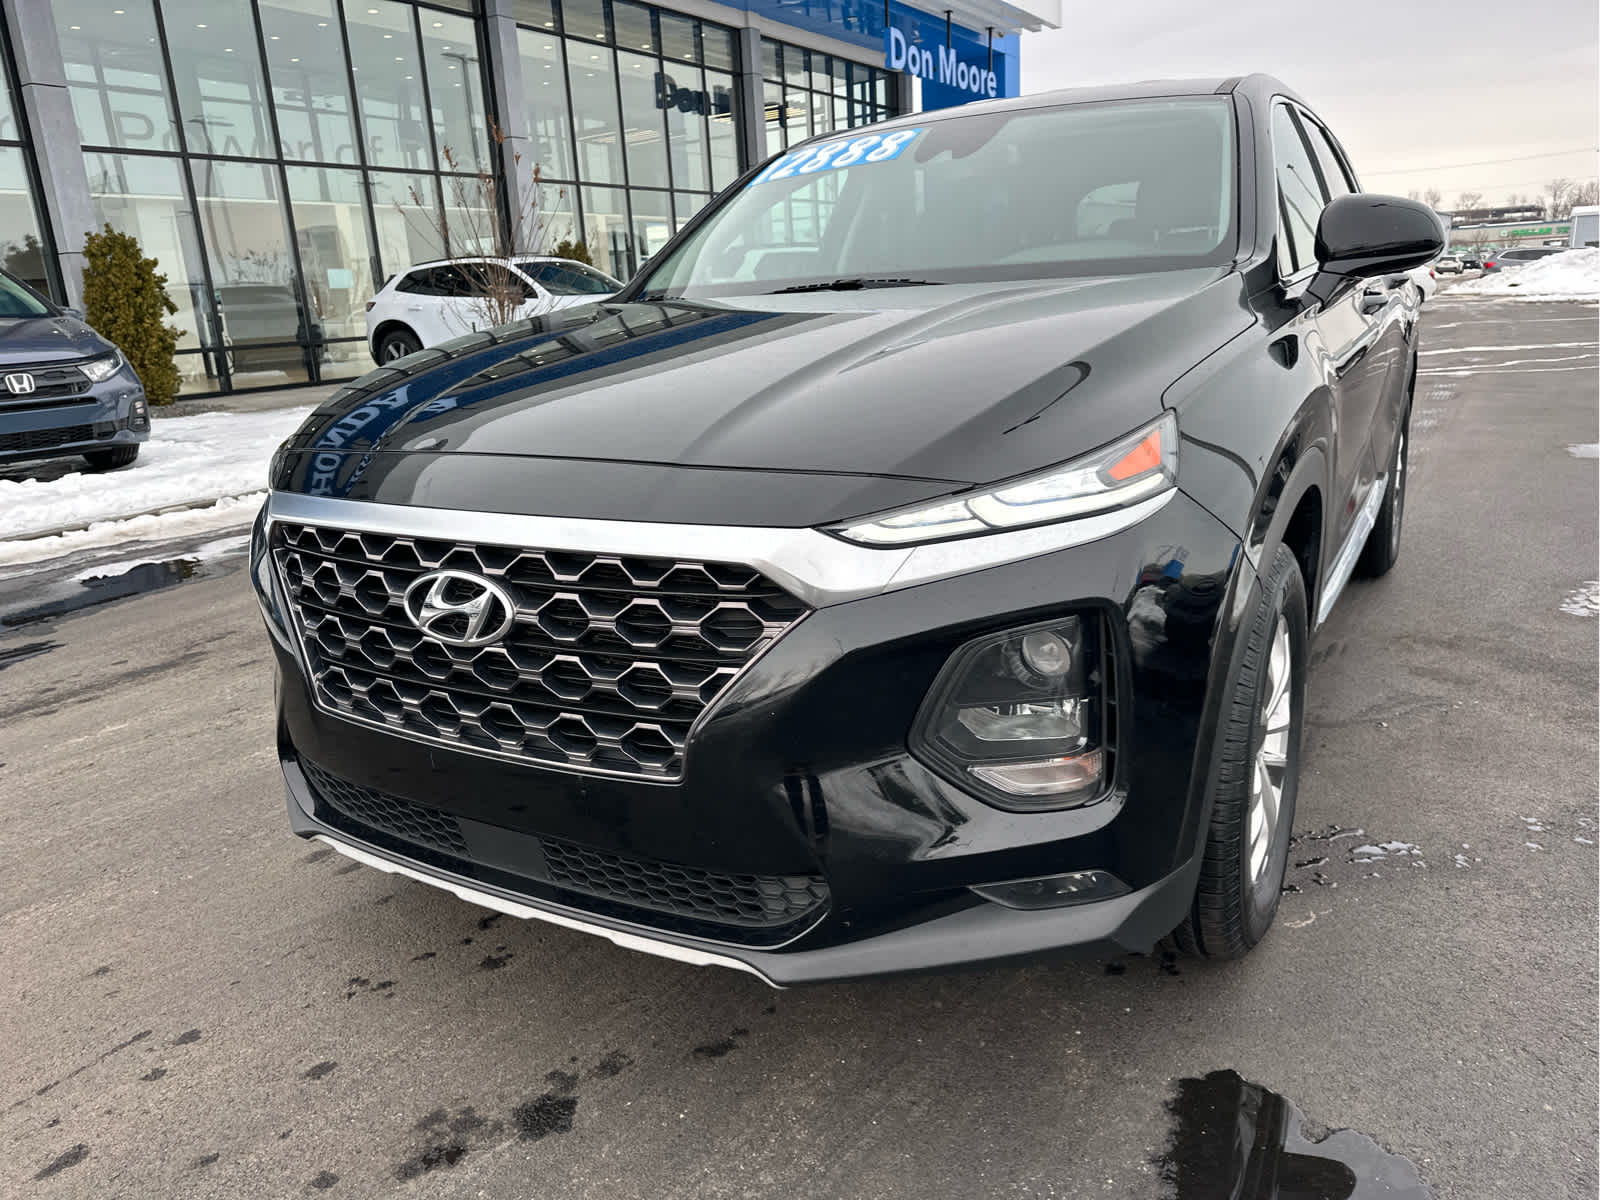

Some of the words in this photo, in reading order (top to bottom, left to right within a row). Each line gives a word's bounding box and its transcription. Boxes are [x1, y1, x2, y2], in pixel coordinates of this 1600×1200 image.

[890, 26, 934, 80] Don
[938, 44, 997, 97] Moore
[752, 130, 915, 185] 12888
